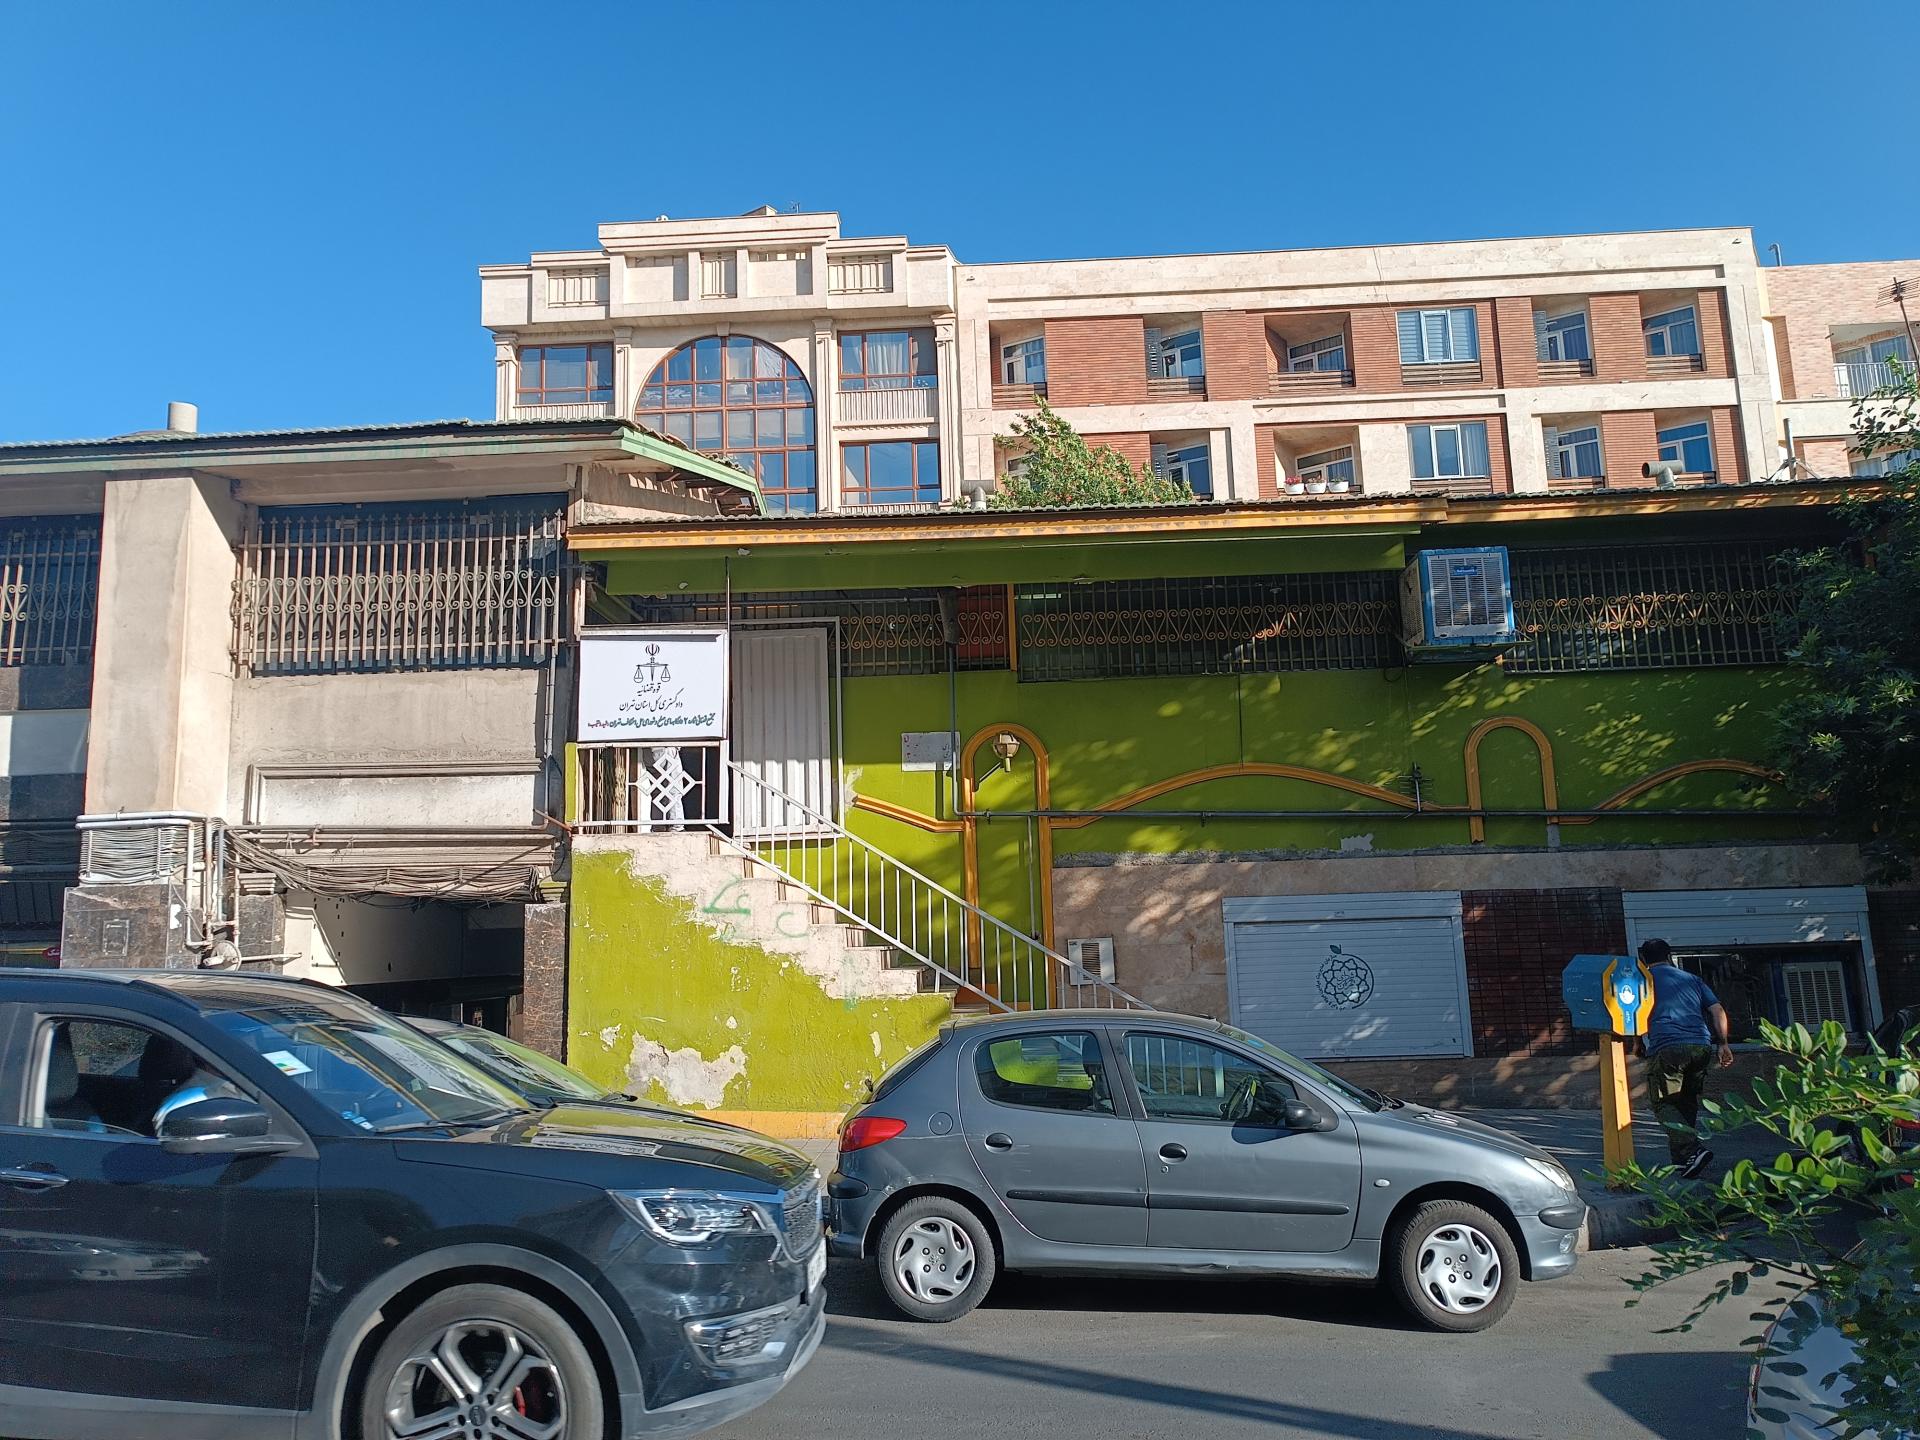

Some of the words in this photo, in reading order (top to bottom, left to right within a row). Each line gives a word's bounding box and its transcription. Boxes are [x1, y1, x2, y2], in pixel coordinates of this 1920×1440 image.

[652, 682, 661, 694] قوه
[619, 699, 636, 712] تهران
[635, 700, 651, 711] استان
[650, 694, 662, 712] کل
[658, 687, 685, 711] دادگستری
